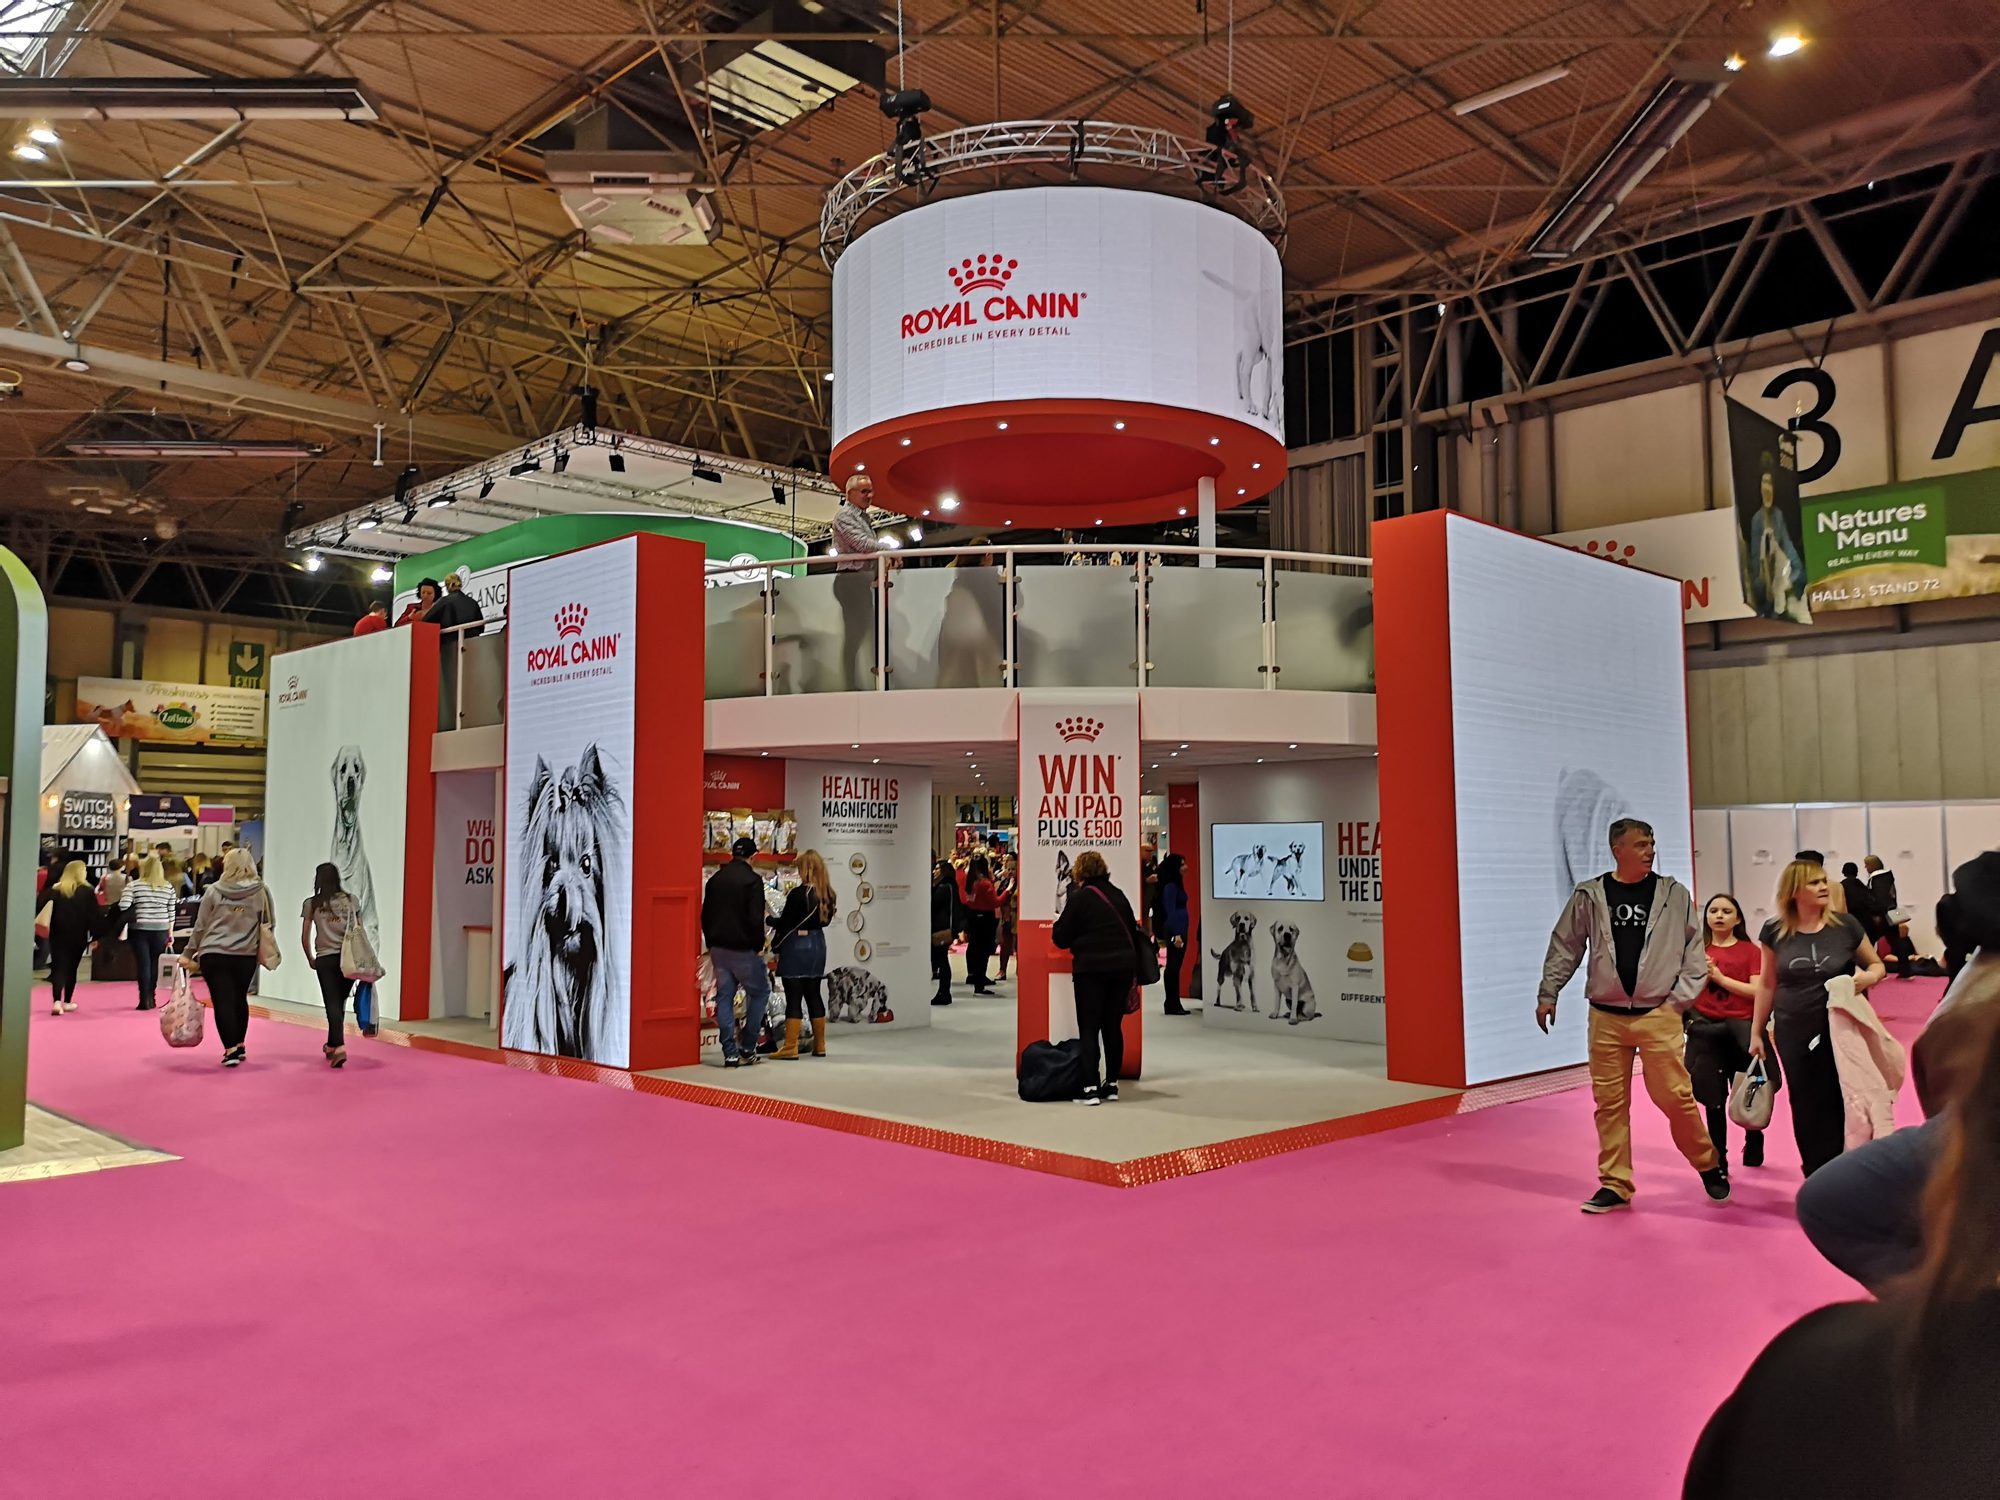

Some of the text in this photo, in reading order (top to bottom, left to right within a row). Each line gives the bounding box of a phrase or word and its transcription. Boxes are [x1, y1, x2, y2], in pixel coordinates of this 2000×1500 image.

[901, 301, 977, 339] ROYAL
[908, 326, 1071, 354] INCREDIBLE IN EVERY DETAIL
[1817, 503, 1927, 533] Natures
[1837, 527, 1909, 550] Menu
[1827, 557, 1851, 568] REAL
[1865, 550, 1896, 561] EVERY
[1898, 549, 1920, 558] WAY
[1811, 588, 1849, 602] HALL
[1869, 581, 1919, 596] STAND
[1923, 578, 1941, 591] 72
[527, 643, 568, 672] ROYAL
[530, 666, 613, 687] INCREDIBLE IN EVERY DETAIL
[822, 776, 899, 801] HEALTH IS
[63, 797, 114, 814] SWITCH
[822, 800, 898, 819] MAGNIFICENT
[1038, 795, 1122, 818] AN IPAD
[63, 814, 114, 830] TO FISH
[1038, 820, 1122, 838] PLUS £500
[1038, 839, 1122, 847] FOR YOUR CHOSEN CHARITY
[465, 867, 494, 885] ASK
[1338, 857, 1380, 879] UNDE
[1339, 880, 1369, 902] THE
